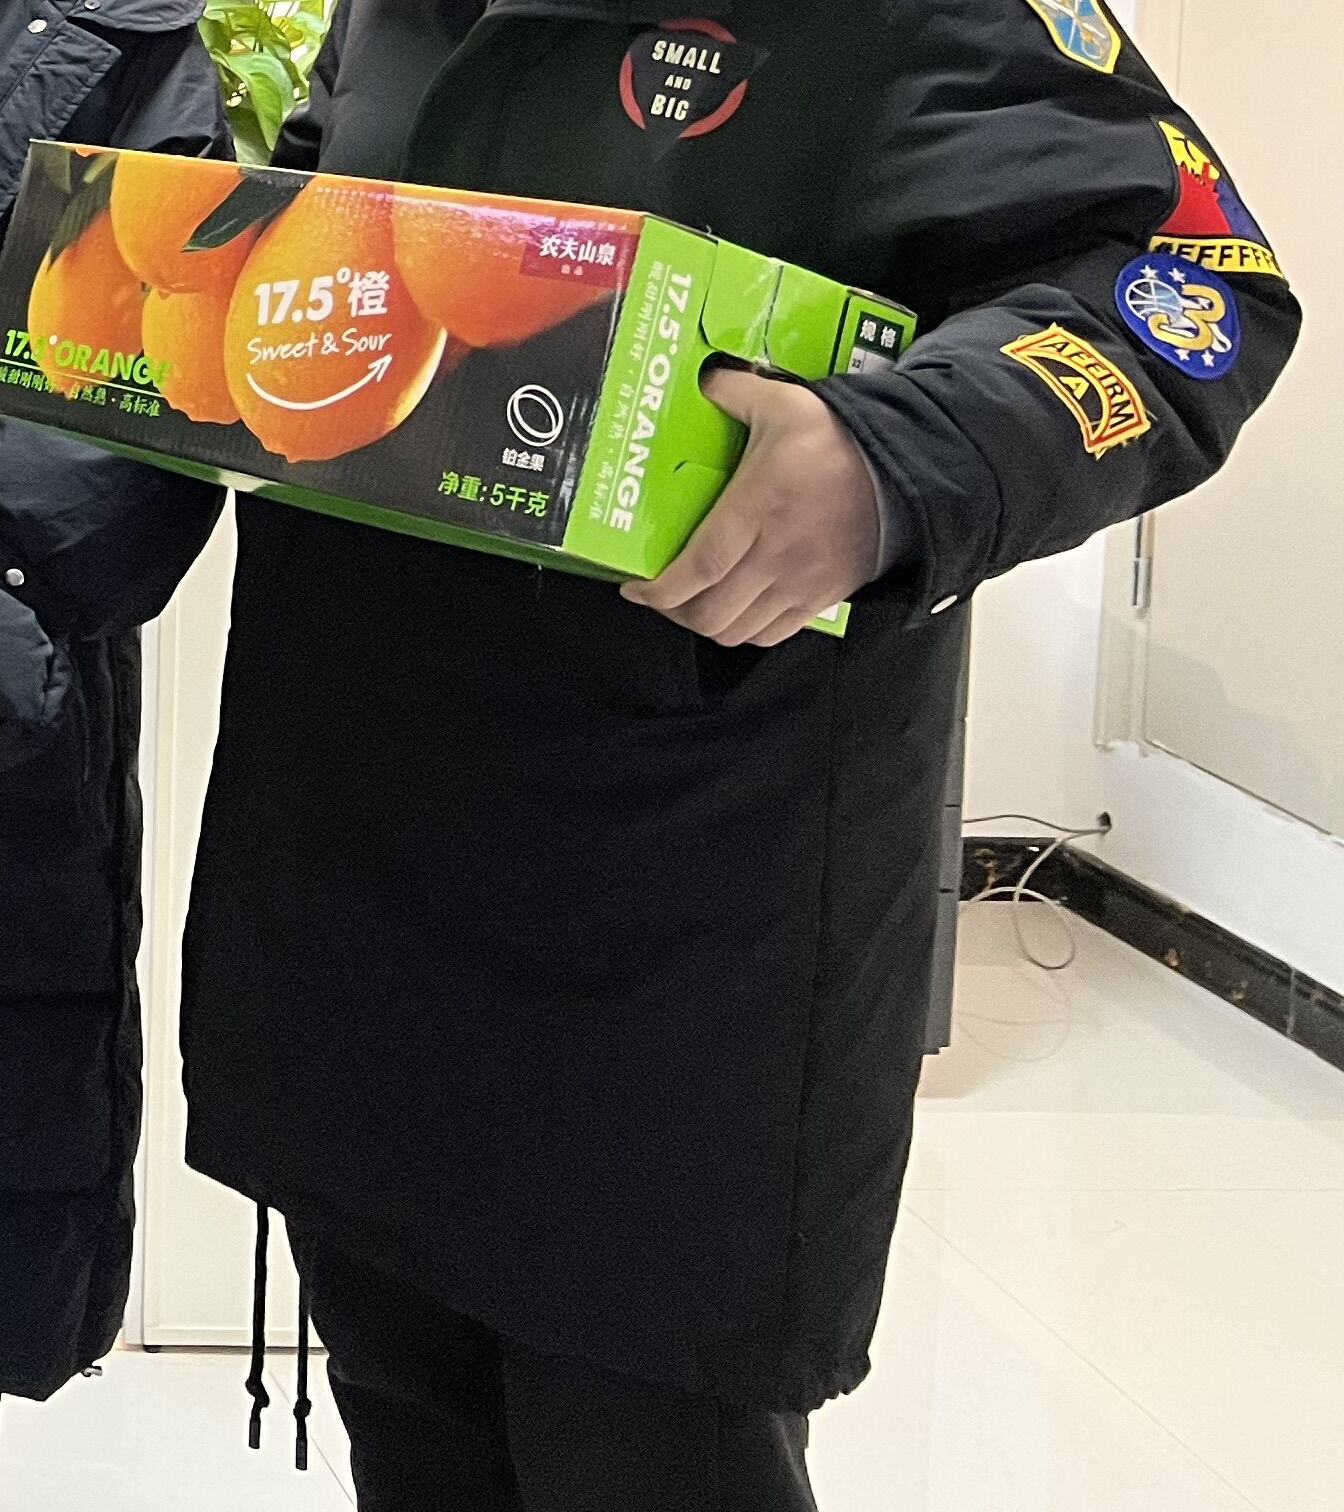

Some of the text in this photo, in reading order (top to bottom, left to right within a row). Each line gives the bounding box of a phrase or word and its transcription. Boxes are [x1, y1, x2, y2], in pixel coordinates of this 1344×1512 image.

[652, 40, 721, 75] SMALL
[664, 74, 692, 91] AND
[650, 93, 690, 121] BIG
[539, 234, 616, 266] 农夫山泉
[246, 328, 392, 365] Sweet & Sour
[1062, 375, 1090, 401] A
[501, 447, 545, 473] 铂金果
